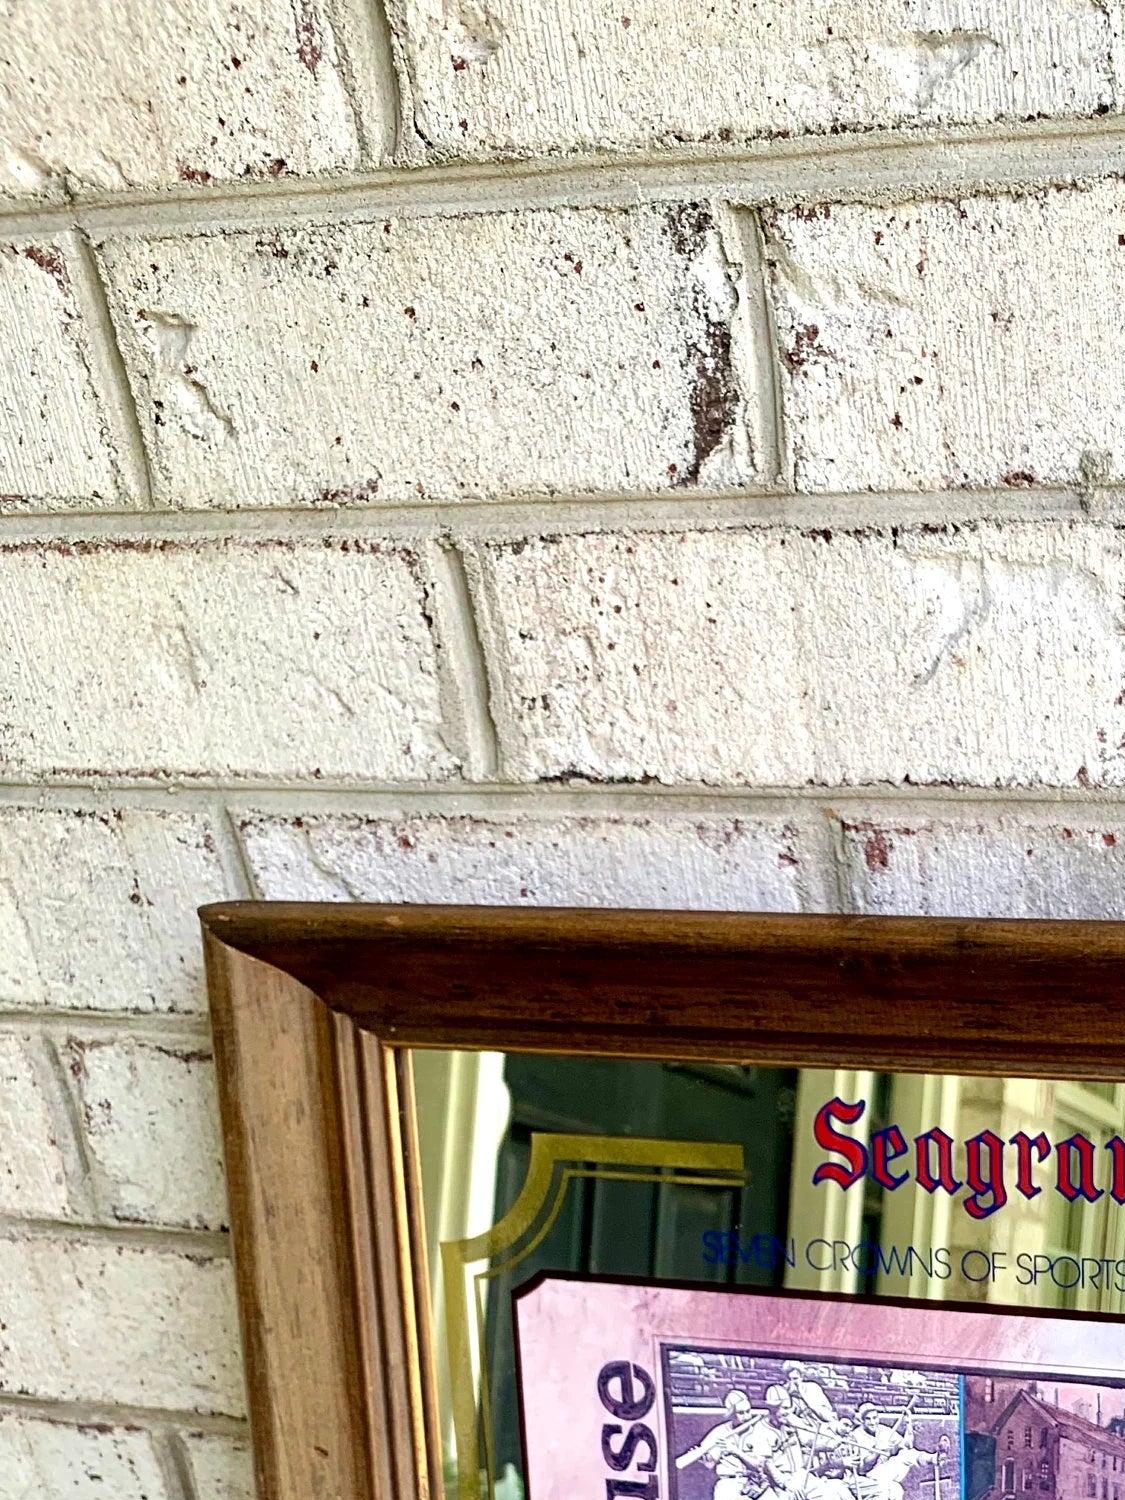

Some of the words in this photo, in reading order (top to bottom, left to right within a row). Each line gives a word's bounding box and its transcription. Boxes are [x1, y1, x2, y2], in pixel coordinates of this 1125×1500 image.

[702, 1230, 795, 1269] SEVEN
[805, 1238, 952, 1280] CROWNS
[961, 1250, 1007, 1284] OF
